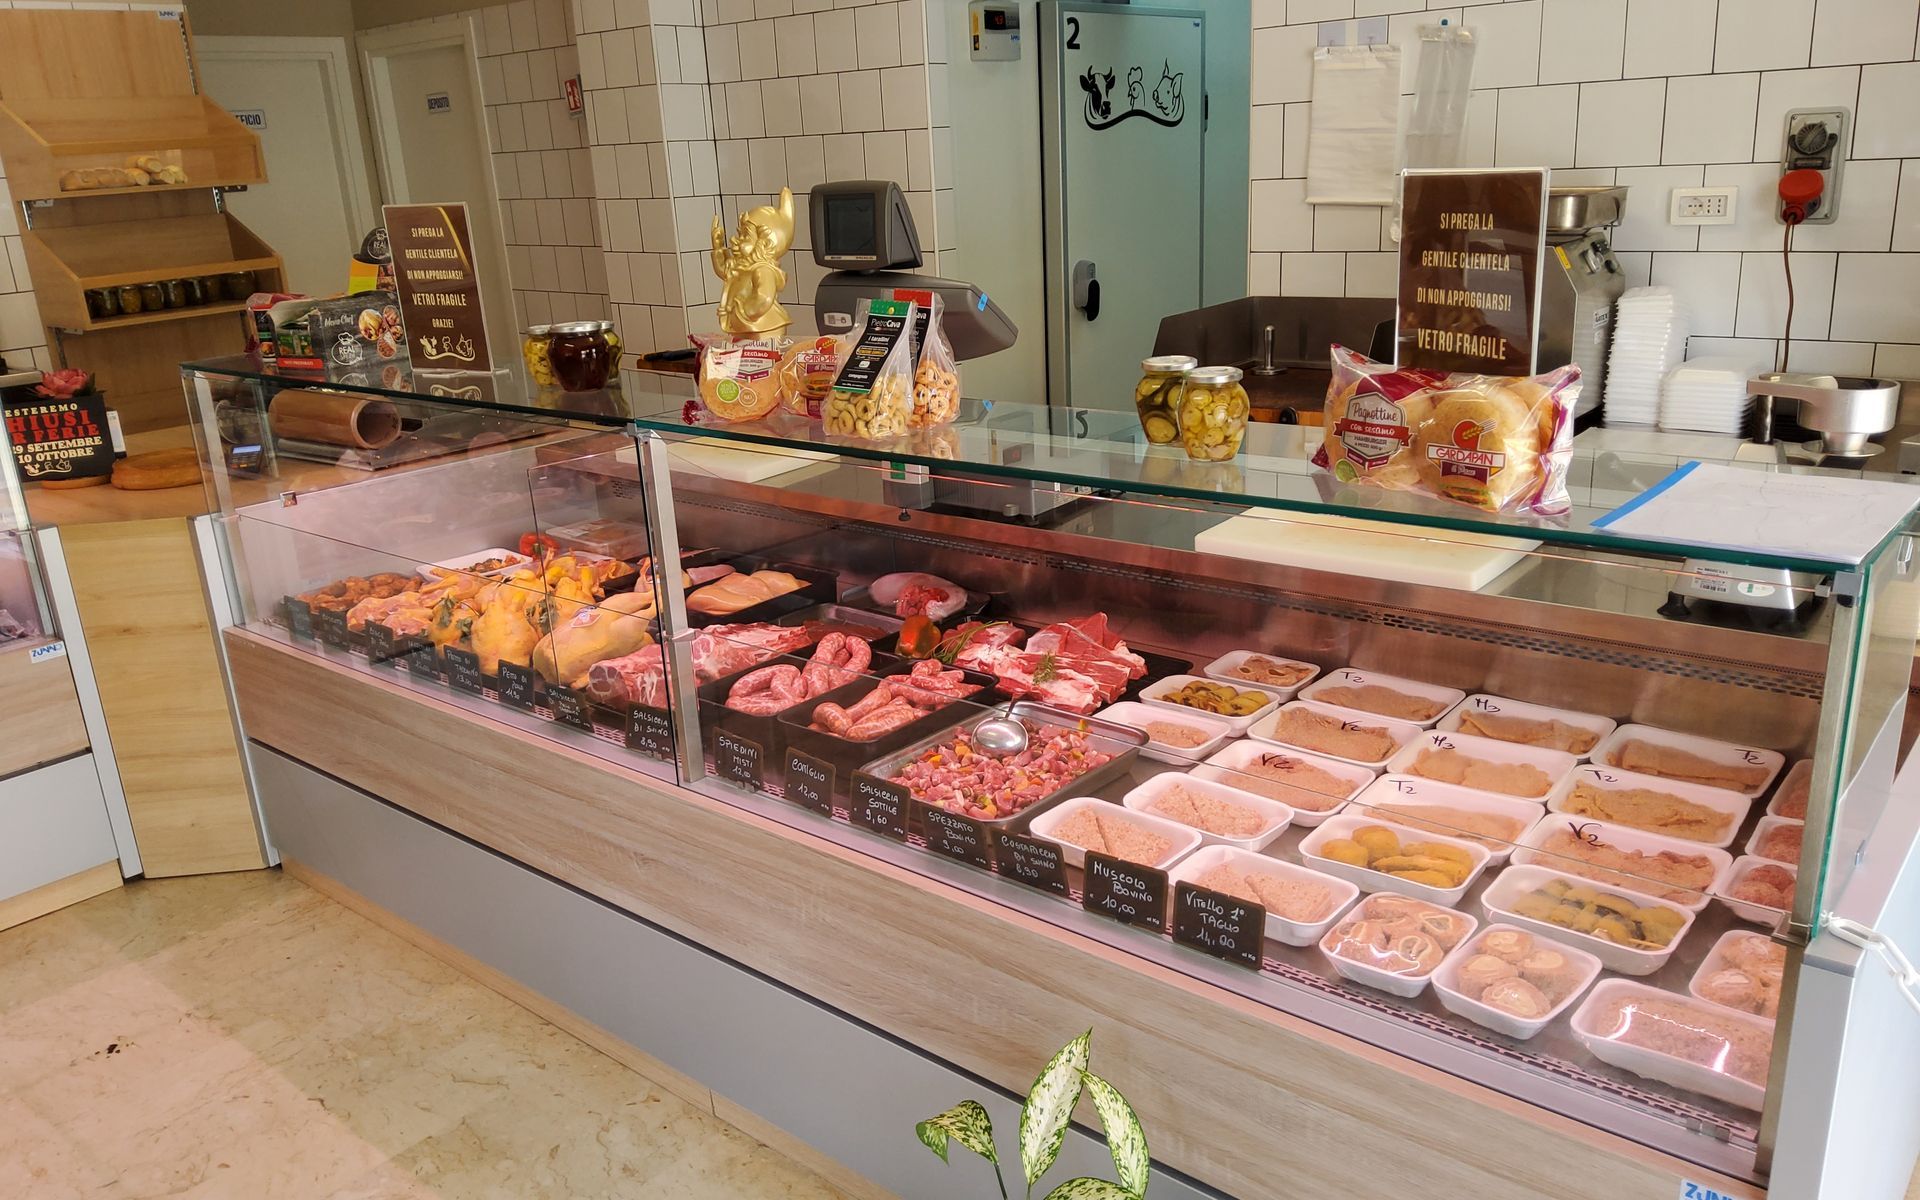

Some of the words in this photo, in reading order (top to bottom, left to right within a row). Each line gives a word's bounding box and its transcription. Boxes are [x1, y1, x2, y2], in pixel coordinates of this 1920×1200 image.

[1066, 17, 1080, 49] 2
[236, 114, 261, 126] FICIO
[1440, 212, 1449, 229] SI
[1451, 213, 1480, 230] PREGA
[1482, 213, 1494, 231] LA
[411, 227, 418, 238] SI
[418, 227, 437, 238] PREGA
[437, 227, 445, 238] LA
[405, 248, 428, 259] GENTILE
[428, 248, 459, 259] CLIENTELA
[1422, 250, 1458, 268] GENTILE
[1460, 252, 1510, 272] CLIENTELA
[406, 269, 414, 280] DI
[413, 269, 426, 280] NON
[412, 293, 437, 306] VETRO
[437, 293, 467, 306] FRAGILE
[1417, 287, 1426, 303] DI
[1427, 288, 1445, 305] NON
[432, 318, 455, 329] GRAZIE!
[1418, 327, 1453, 353] VETRO
[1456, 332, 1507, 360] FRAGILE
[5, 402, 79, 418] ESTEREMO
[1352, 402, 1398, 423] Pagnottine
[5, 409, 91, 433] HIUSI
[34, 423, 100, 444] FERIE
[27, 436, 103, 453] SETTEMBRE
[18, 454, 32, 464] 10
[36, 446, 95, 461] OTTOBRE
[1435, 448, 1494, 466] GARDAPAN
[633, 709, 669, 727] SALSICCIA
[718, 736, 758, 760] SPIEDINI
[733, 755, 753, 769] MISTI
[791, 758, 826, 782] CONIGLIO
[797, 782, 819, 801] 12,00
[859, 782, 899, 804] SALSICCIA
[868, 797, 898, 816] SOTTILE
[865, 808, 888, 825] 9,60
[928, 811, 974, 833] SPEZZATO
[944, 827, 977, 845] BOVINO
[1112, 880, 1153, 903] BOVINO
[1101, 895, 1136, 915] 10,00
[1199, 912, 1240, 933] TAGLIO
